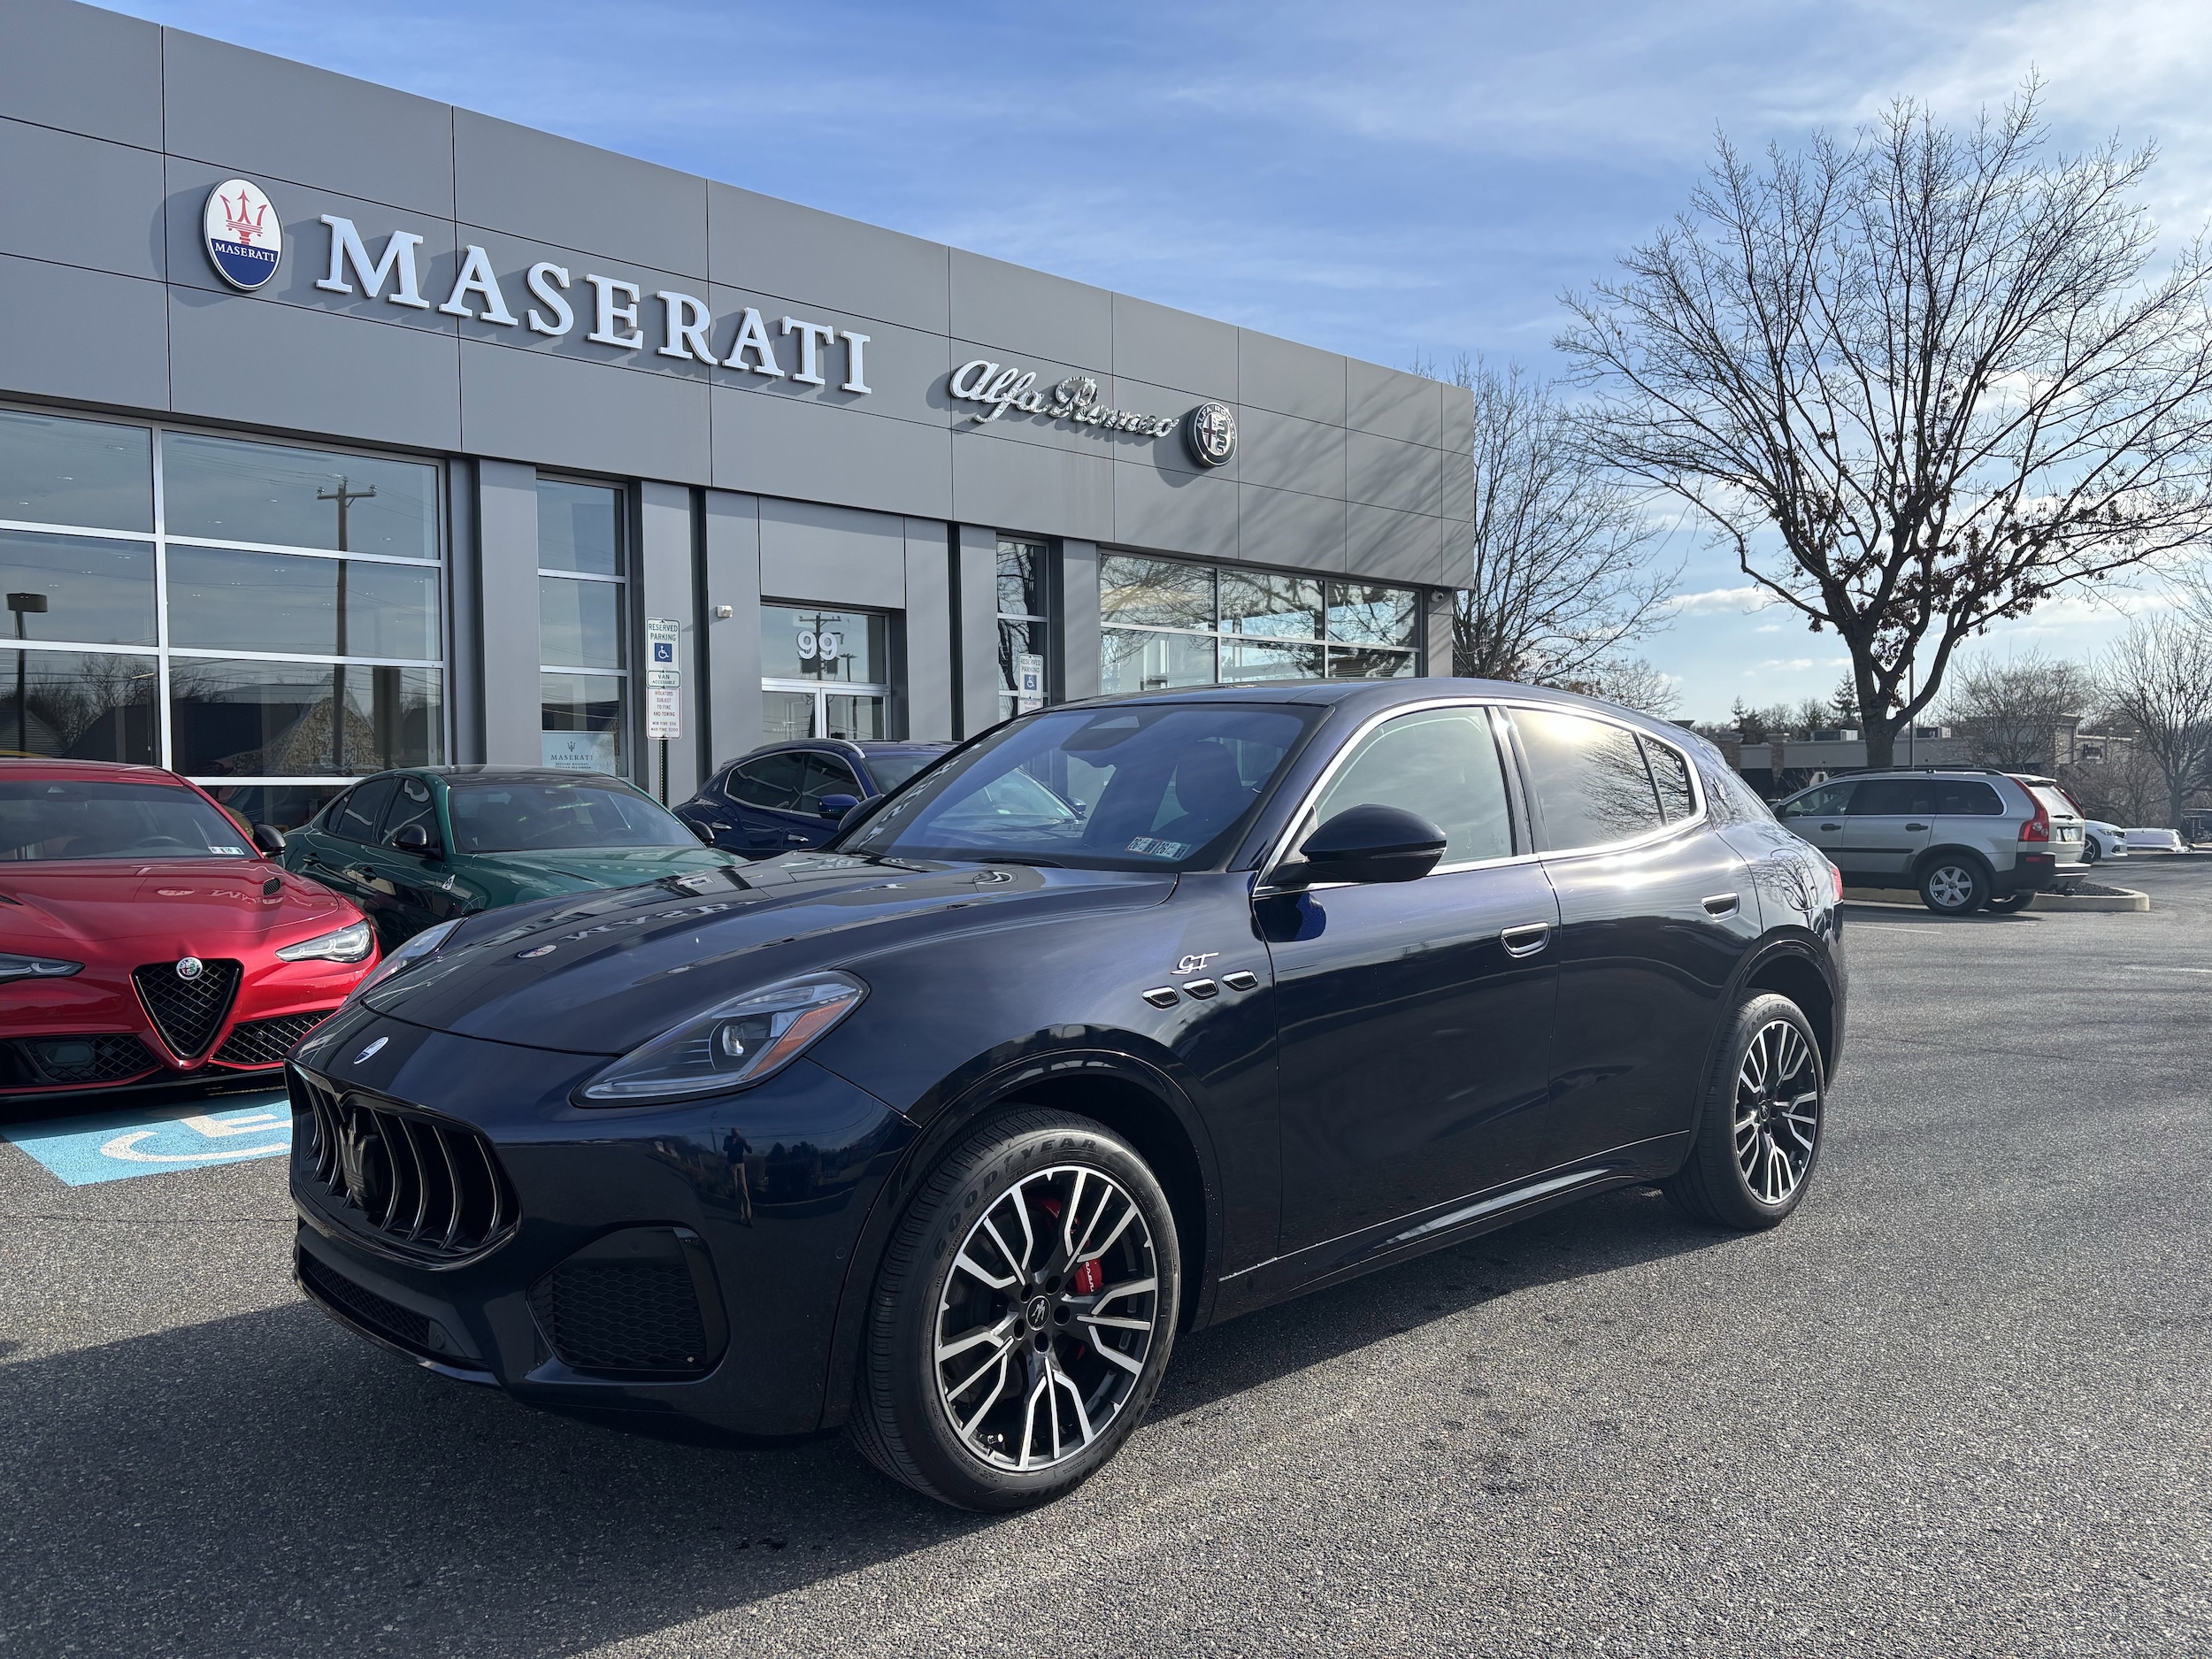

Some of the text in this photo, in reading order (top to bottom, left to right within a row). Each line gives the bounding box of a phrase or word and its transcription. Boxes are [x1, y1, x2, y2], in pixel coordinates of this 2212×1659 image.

[215, 242, 275, 263] MASERATI
[316, 213, 872, 395] MASERATI
[949, 359, 1181, 438] Alfa Romeo
[1196, 406, 1213, 430] ALFA
[649, 623, 678, 633] RESERVED
[649, 633, 677, 641] PARKING
[797, 630, 838, 661] 99
[1020, 657, 1041, 666] RESERVED
[1171, 951, 1219, 975] GT
